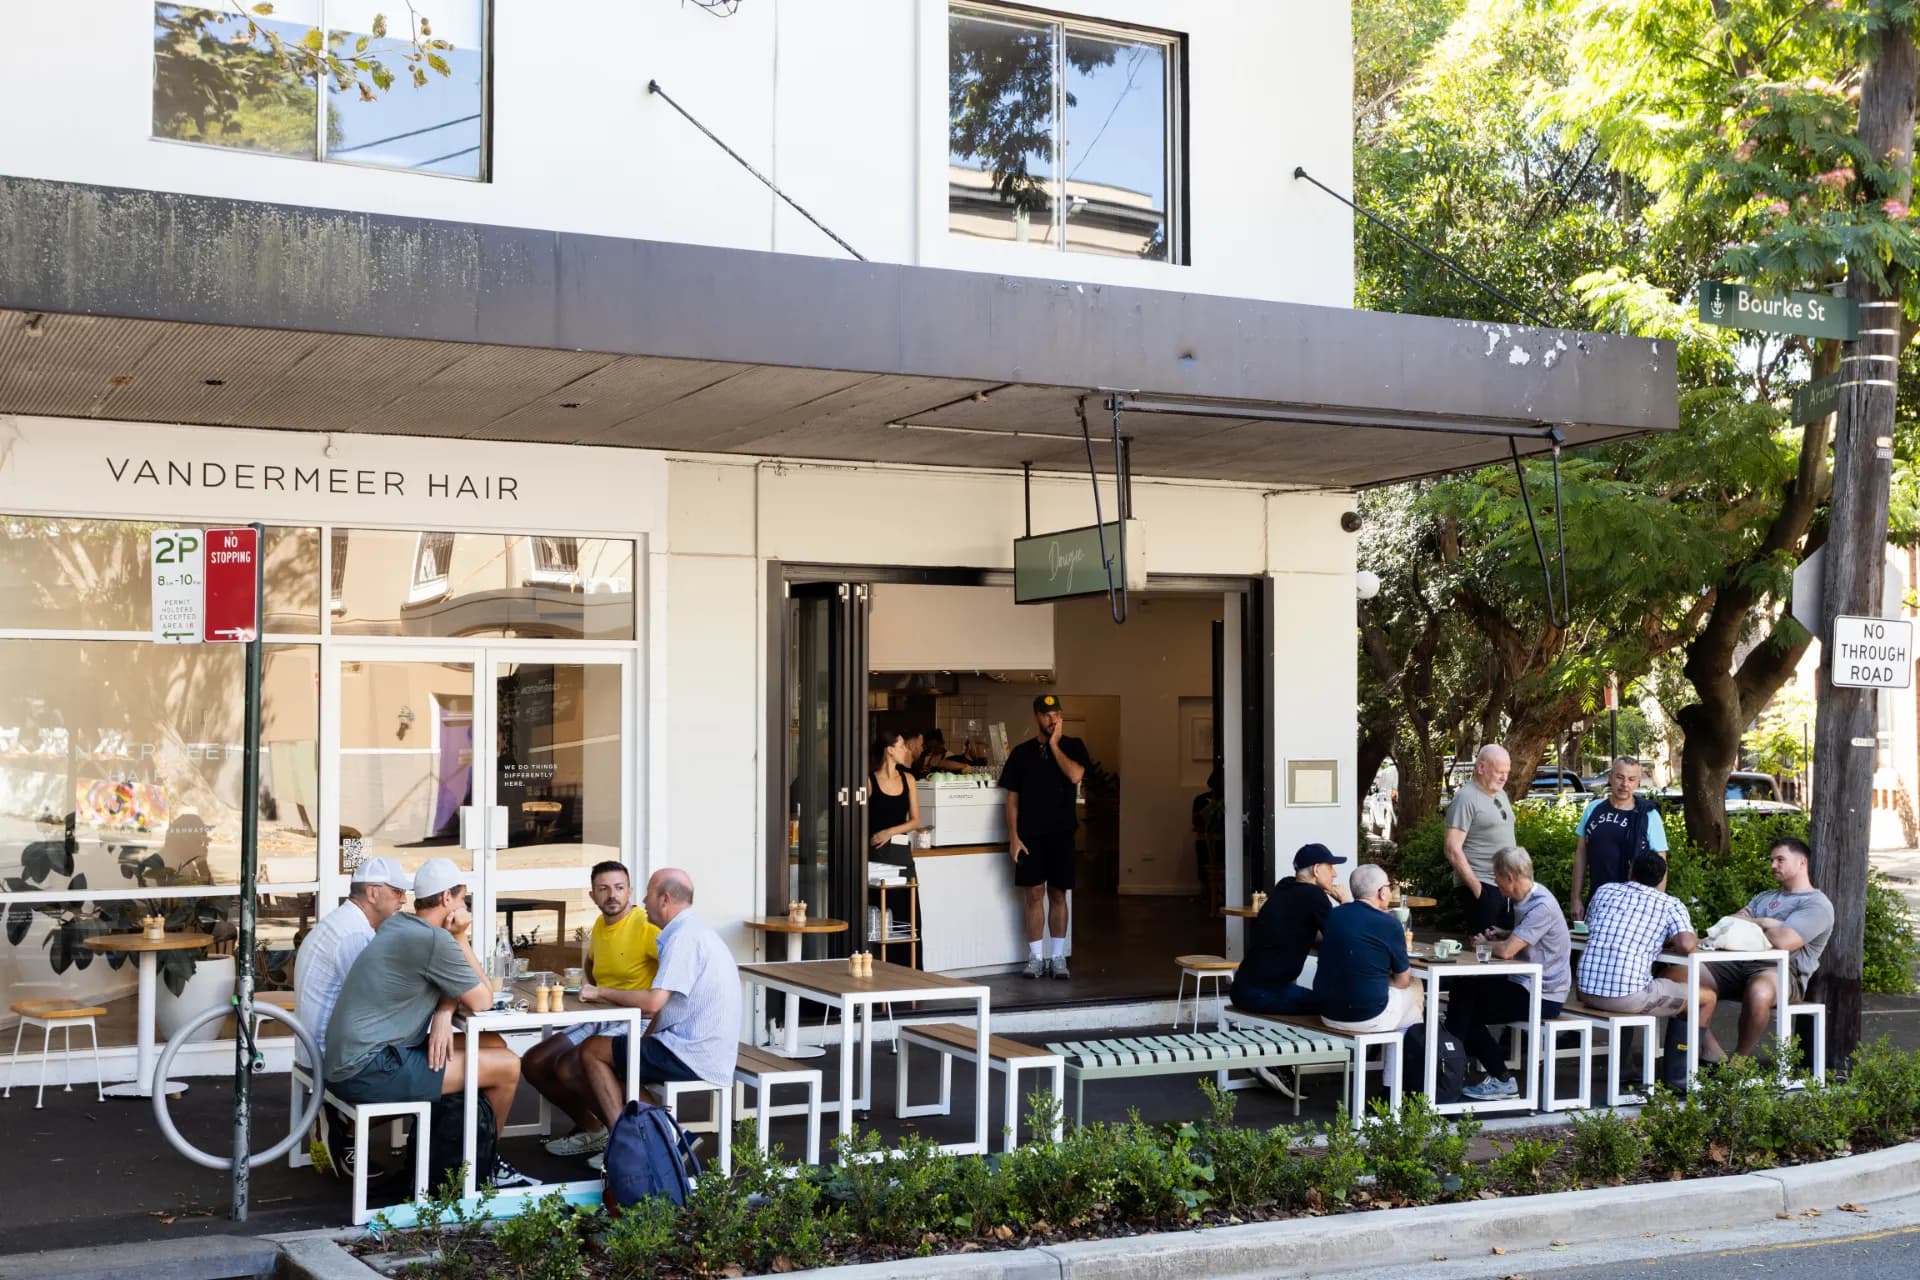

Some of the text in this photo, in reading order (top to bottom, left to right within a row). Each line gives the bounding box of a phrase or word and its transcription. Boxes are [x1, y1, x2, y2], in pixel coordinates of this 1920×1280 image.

[1738, 291, 1825, 321] Bourke St
[106, 457, 518, 501] VANDERMEER HAIR
[155, 537, 198, 563] 2P
[224, 536, 238, 548] NO
[211, 551, 251, 564] STOPPING
[159, 613, 196, 621] EXCEPTED
[1864, 623, 1885, 640] NO
[1841, 643, 1906, 662] THROUGH
[1851, 665, 1894, 682] ROAD
